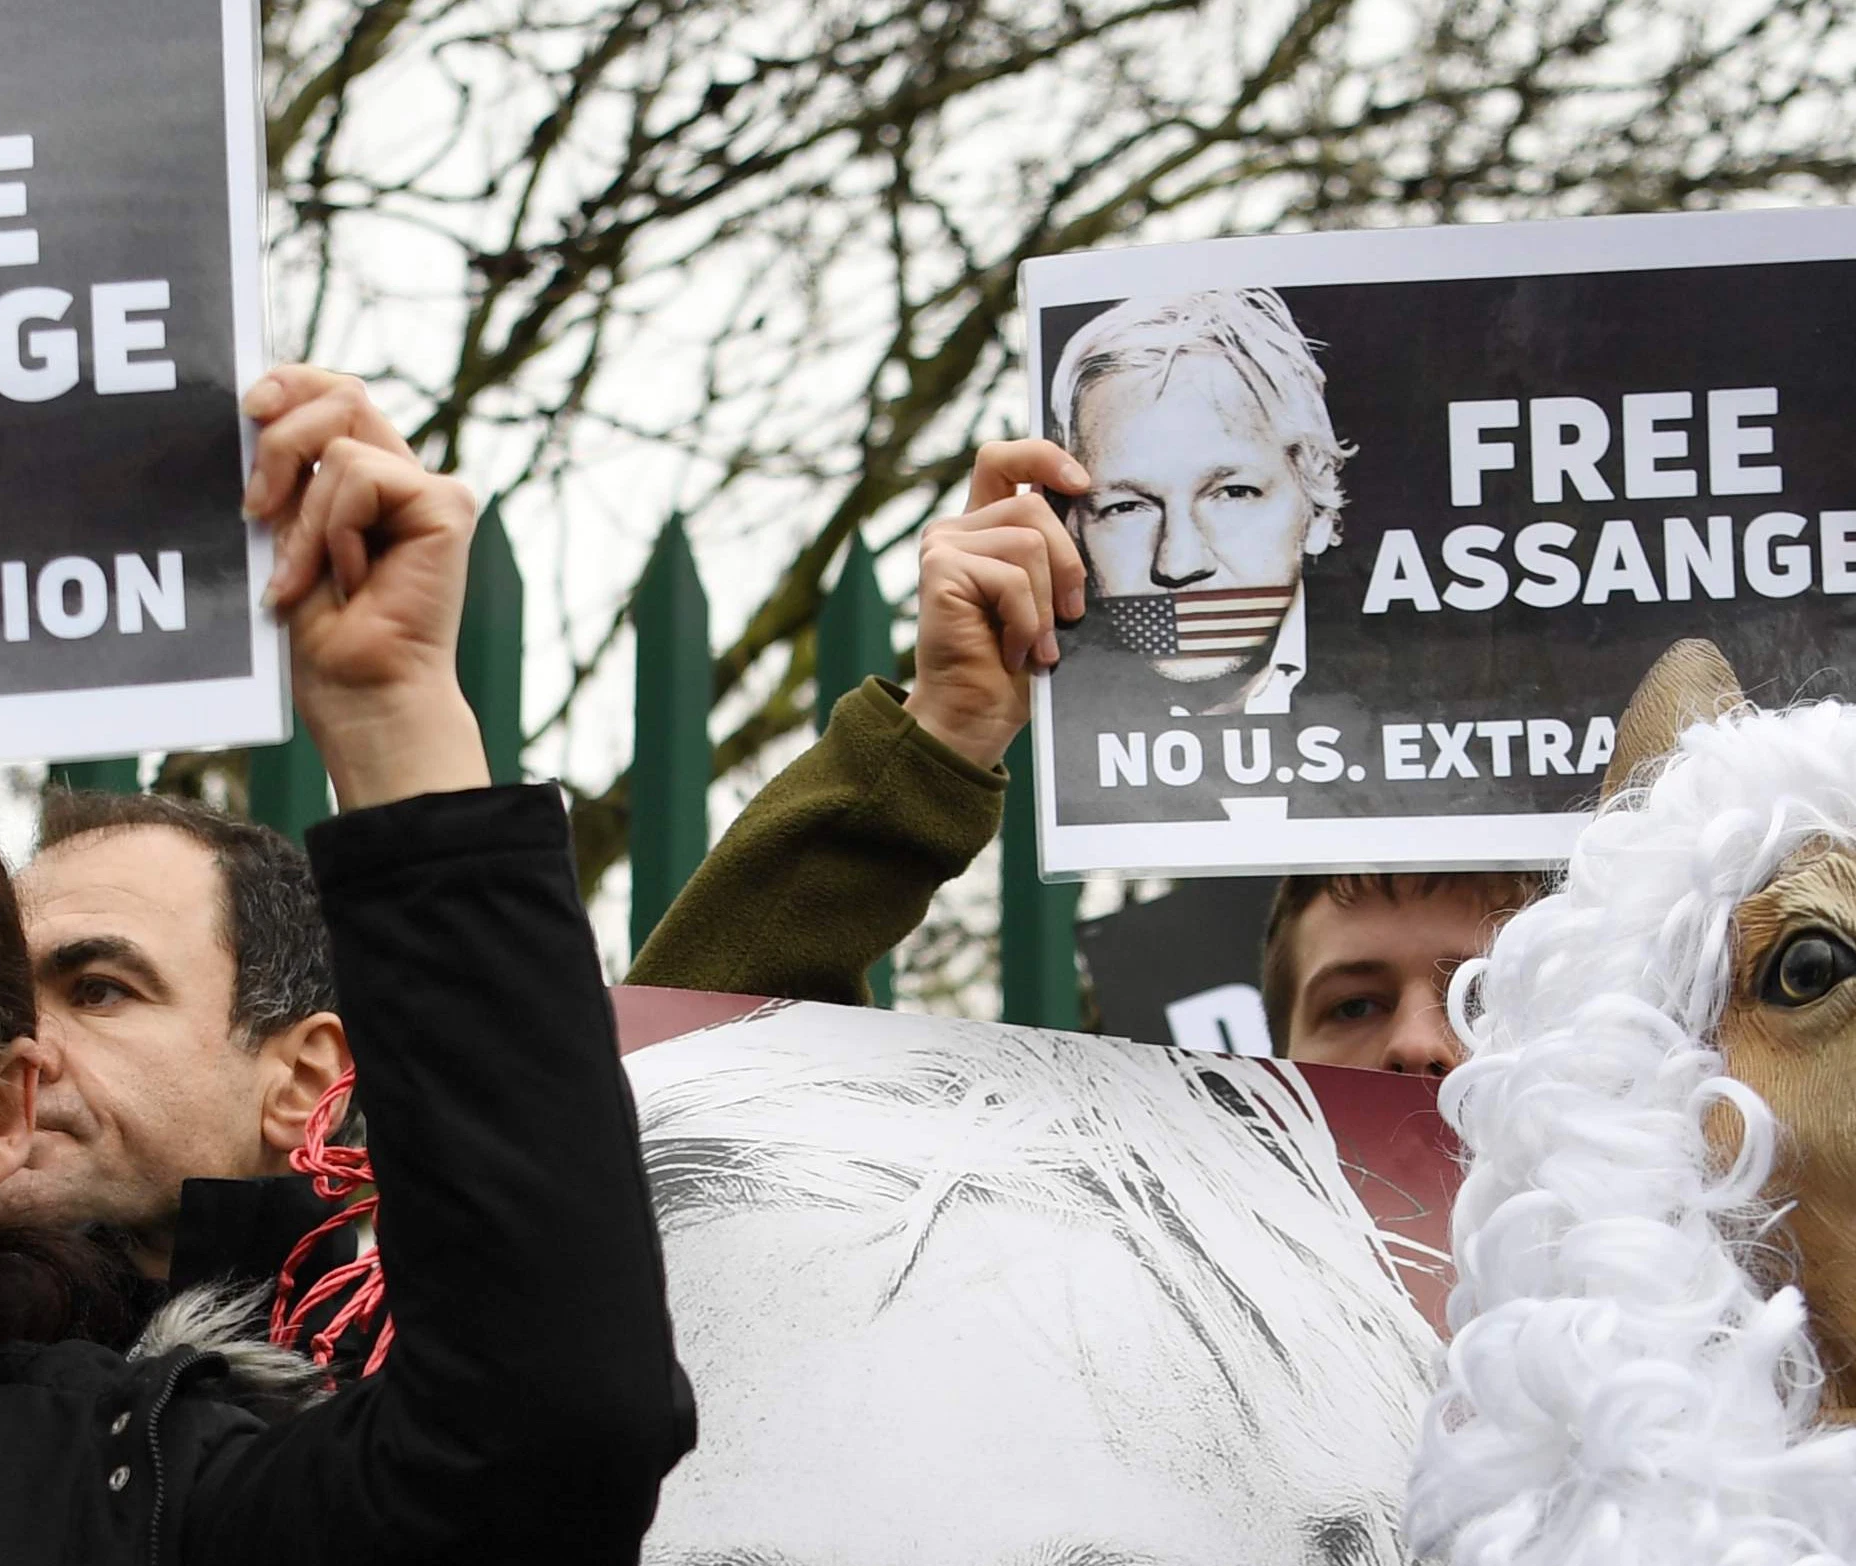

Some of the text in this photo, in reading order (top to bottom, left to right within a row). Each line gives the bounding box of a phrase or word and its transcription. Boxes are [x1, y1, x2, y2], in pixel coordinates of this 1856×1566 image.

[1448, 387, 1783, 507] FREE
[1098, 729, 1203, 787] NO
[1222, 725, 1366, 785] U.S.
